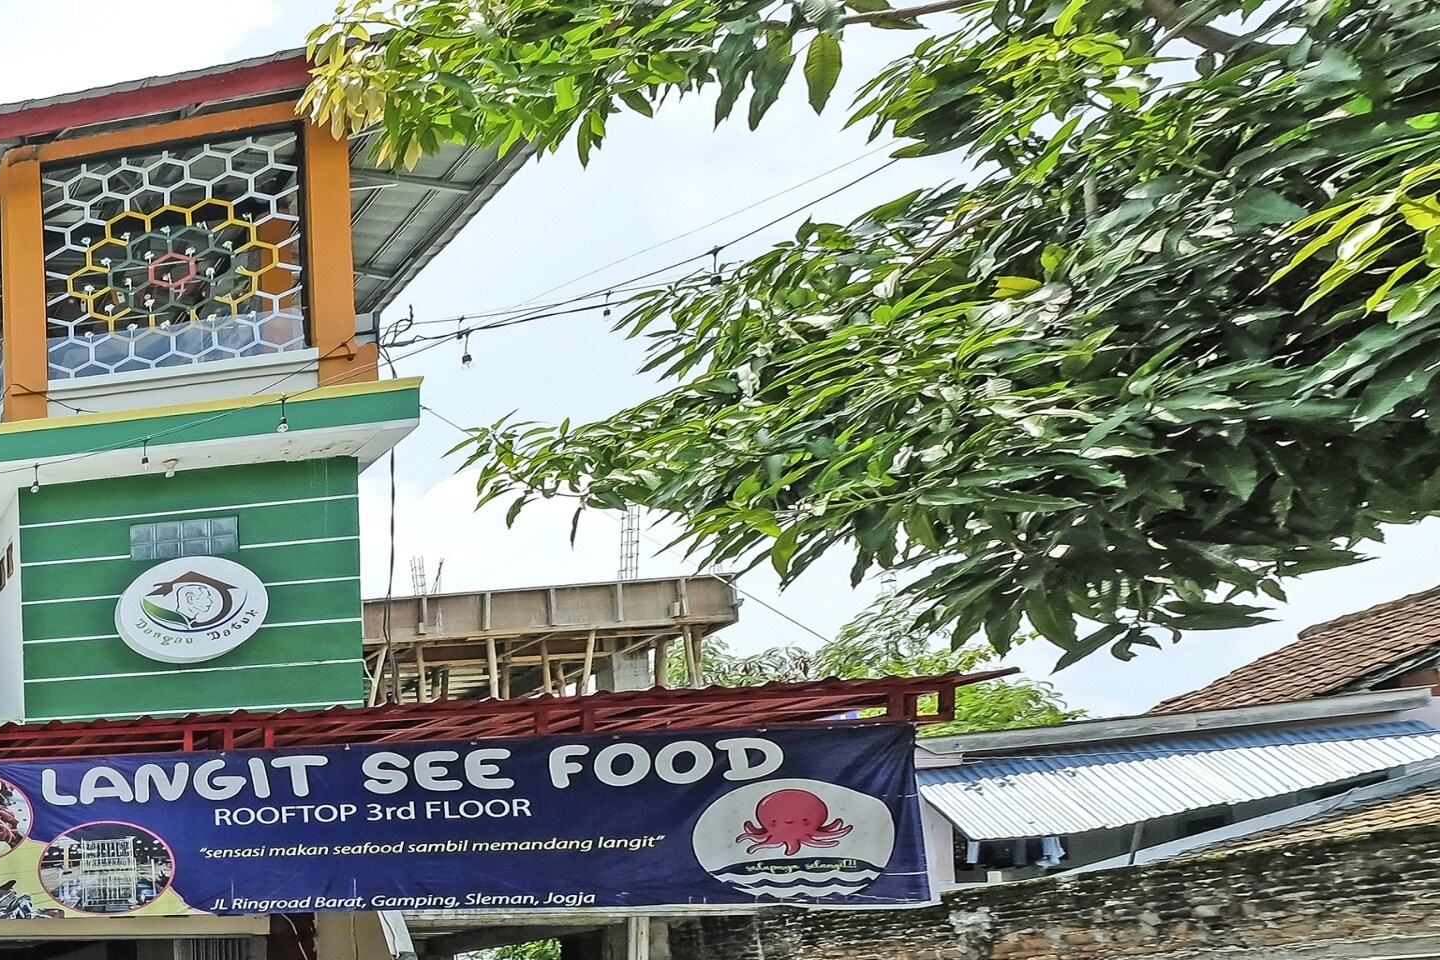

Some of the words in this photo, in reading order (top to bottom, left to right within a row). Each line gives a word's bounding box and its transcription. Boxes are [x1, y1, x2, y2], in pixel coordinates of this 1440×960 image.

[41, 755, 329, 806] LANGIT
[361, 746, 515, 795] SEE
[548, 737, 784, 789] FOOD
[215, 803, 357, 826] ROOFTOP
[366, 801, 416, 821] 3rd
[425, 799, 532, 819] FLOOR
[269, 844, 329, 857] makan
[333, 841, 404, 856] seafood
[408, 840, 468, 853] sambil
[472, 837, 593, 852] memandang
[210, 898, 228, 910] JL
[232, 896, 311, 912] Ringroad
[314, 896, 367, 909] Barat,
[371, 894, 460, 908] Gamping,
[465, 892, 539, 906] Sleman,
[543, 891, 596, 906] Jogja
